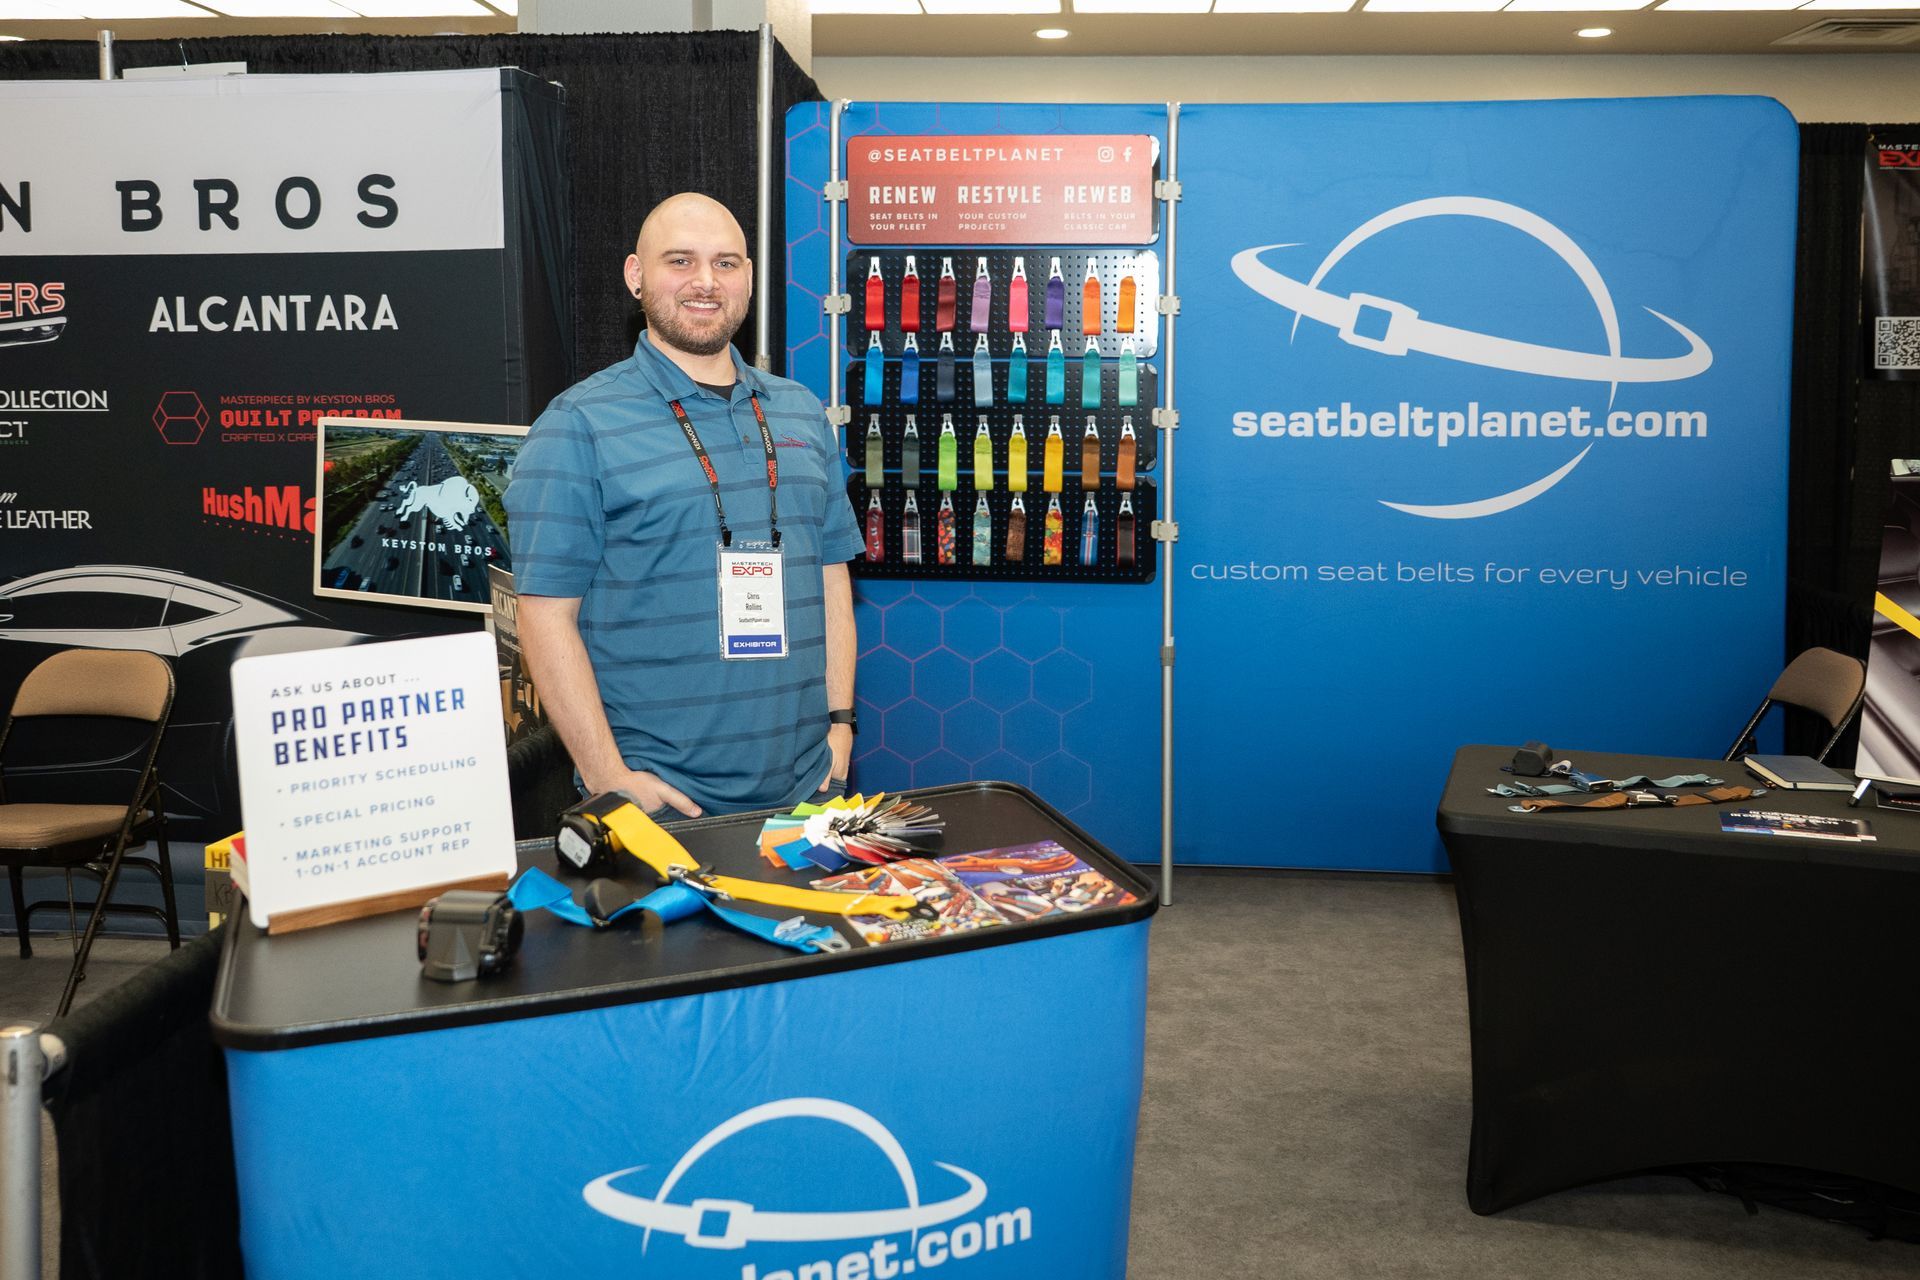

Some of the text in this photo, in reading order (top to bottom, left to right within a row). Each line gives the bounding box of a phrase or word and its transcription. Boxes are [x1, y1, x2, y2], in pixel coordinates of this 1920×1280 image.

[868, 148, 1064, 162] @SEATBELTPLANET
[1879, 151, 1920, 167] EX
[115, 174, 399, 232] BROS
[869, 186, 936, 204] RENEW
[958, 185, 1042, 204] RESTYLE
[1063, 185, 1132, 204] REWEB
[869, 223, 927, 231] YOUR FLEET
[958, 223, 1006, 231] PROJECTS
[1063, 223, 1128, 231] CLASSIC CAR
[149, 294, 399, 332] ALCANTARA
[220, 394, 396, 405] MASTERPIECE BY KEYSTON BROS
[220, 409, 292, 428] QUILT
[1232, 402, 1708, 447] seatbeltplanet.com
[221, 433, 276, 443] CRAFTED
[278, 433, 285, 442] X
[683, 422, 702, 451] KENWOOD
[761, 426, 773, 453] KENWOOD
[6, 510, 93, 529] LEATHER
[382, 538, 493, 557] KEYSTON BROS
[732, 566, 773, 576] EXPO
[1191, 561, 1748, 590] custom seat belts for every vehicle
[271, 685, 303, 698] ASK
[311, 682, 333, 693] US
[341, 674, 397, 690] ABOUT
[272, 688, 465, 734] PRO PARTNER
[274, 726, 408, 766] BENEFITS
[290, 756, 477, 794] PRIORITY SCHEDULING
[293, 795, 436, 828] SPECIAL PRICING
[296, 821, 472, 861] MARKETING SUPPORT
[296, 838, 471, 879] 1-ON-1 ACCOUNT REP
[742, 1207, 1032, 1280] net.com
